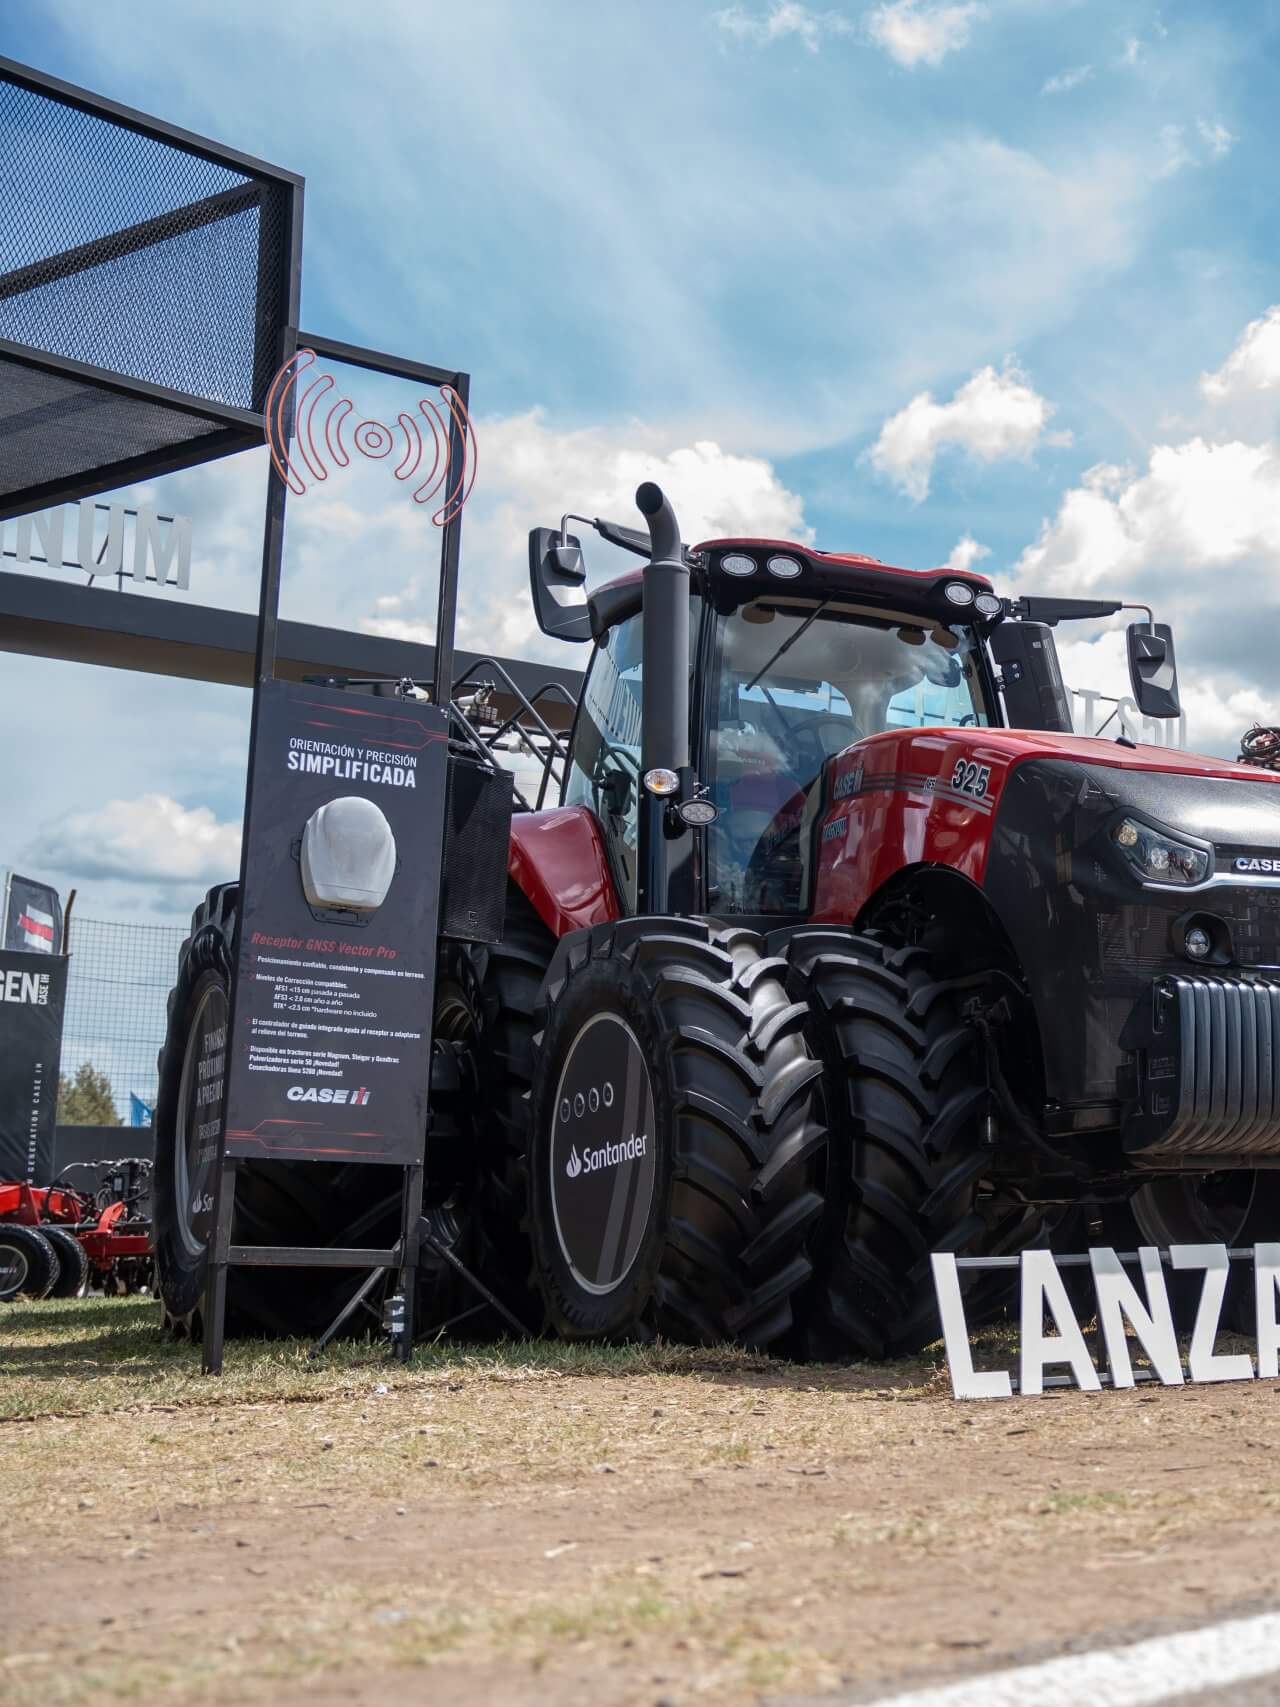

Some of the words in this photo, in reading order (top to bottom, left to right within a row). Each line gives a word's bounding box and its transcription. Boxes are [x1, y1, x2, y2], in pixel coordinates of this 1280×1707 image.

[0, 499, 192, 591] NUM
[290, 737, 355, 758] ORIENTACIÓN
[357, 749, 364, 758] Y
[366, 750, 417, 768] PRECISIÓN
[287, 751, 417, 789] SIMPLIFICADA
[951, 757, 992, 799] 325
[251, 932, 304, 949] Receptor
[306, 939, 337, 952] GNSS
[339, 941, 375, 957] Vector
[376, 944, 397, 959] Pro
[40, 974, 50, 983] IH
[38, 985, 48, 1005] CASE
[286, 1086, 350, 1104] CASE
[583, 1133, 648, 1174] Santander
